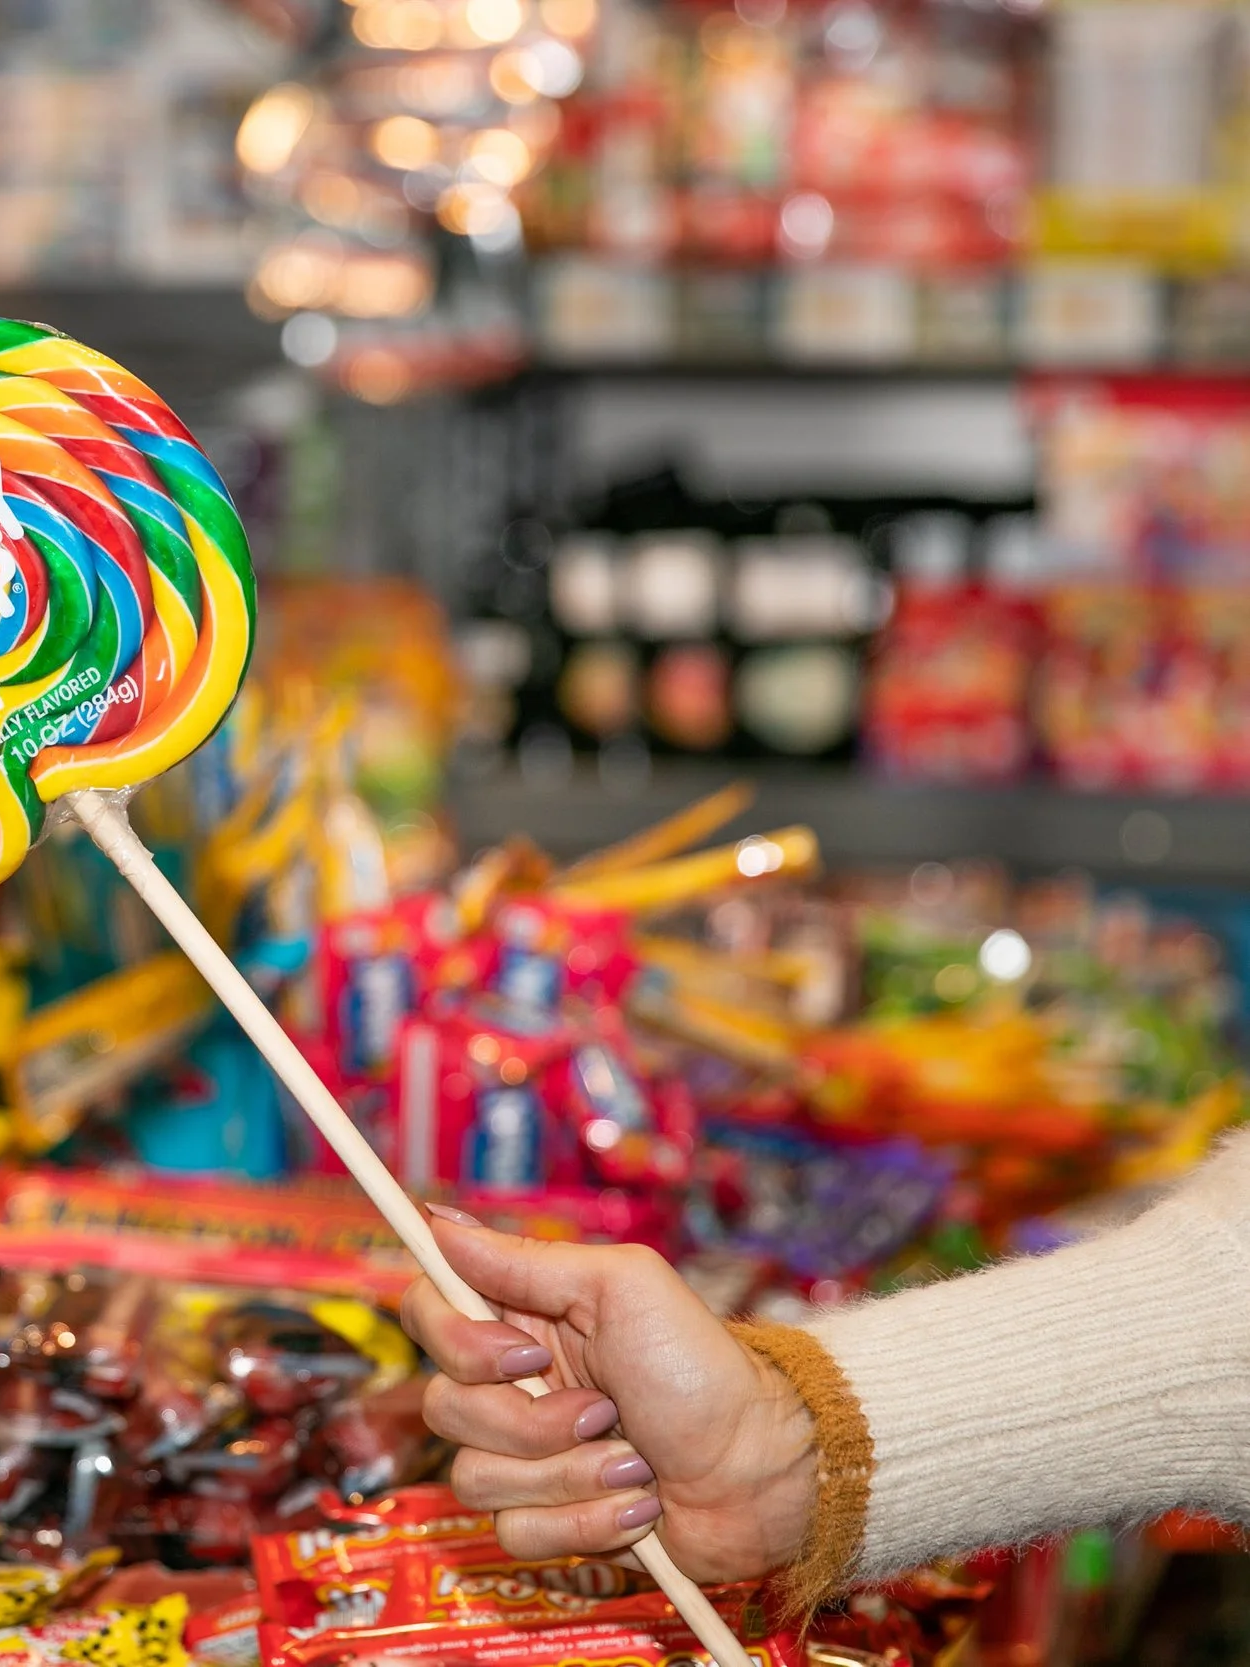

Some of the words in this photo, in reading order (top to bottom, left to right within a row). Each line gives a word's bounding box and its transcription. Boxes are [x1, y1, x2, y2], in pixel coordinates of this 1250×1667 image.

[10, 737, 39, 764] 10
[39, 715, 76, 747] OZ
[75, 675, 139, 729] (284g)
[23, 666, 101, 724] FLAVORED
